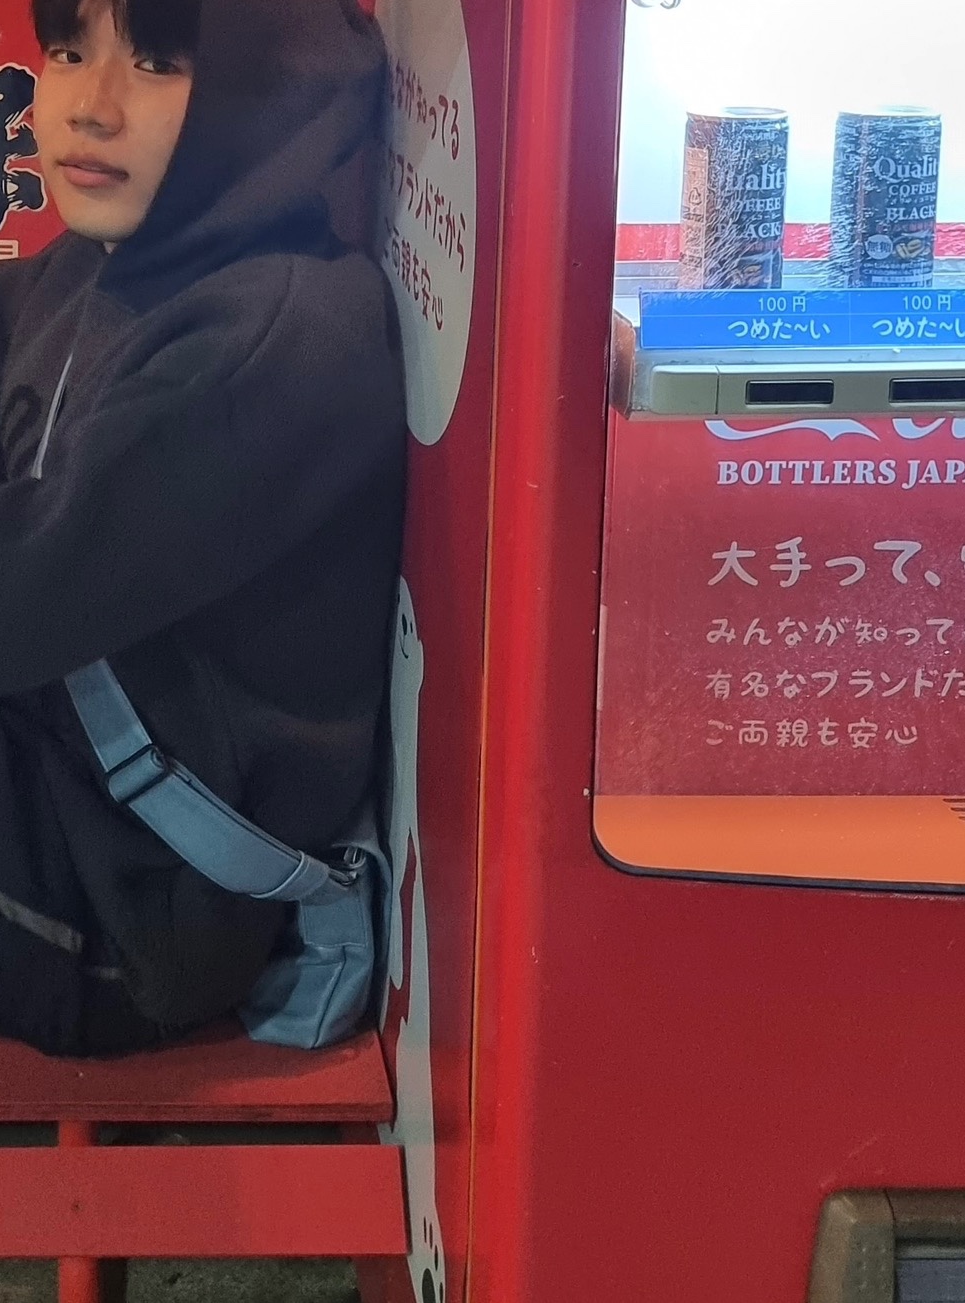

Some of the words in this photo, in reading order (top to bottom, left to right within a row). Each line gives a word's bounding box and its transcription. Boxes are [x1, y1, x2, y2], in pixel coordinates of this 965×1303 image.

[757, 297, 787, 312] 100
[792, 297, 807, 313] 円
[902, 296, 932, 311] 100
[937, 295, 952, 312] 円
[717, 459, 897, 486] BOTTLERS
[901, 459, 965, 490] JAP
[707, 536, 965, 588] 大手って、
[705, 717, 918, 749] ご両親も安心
